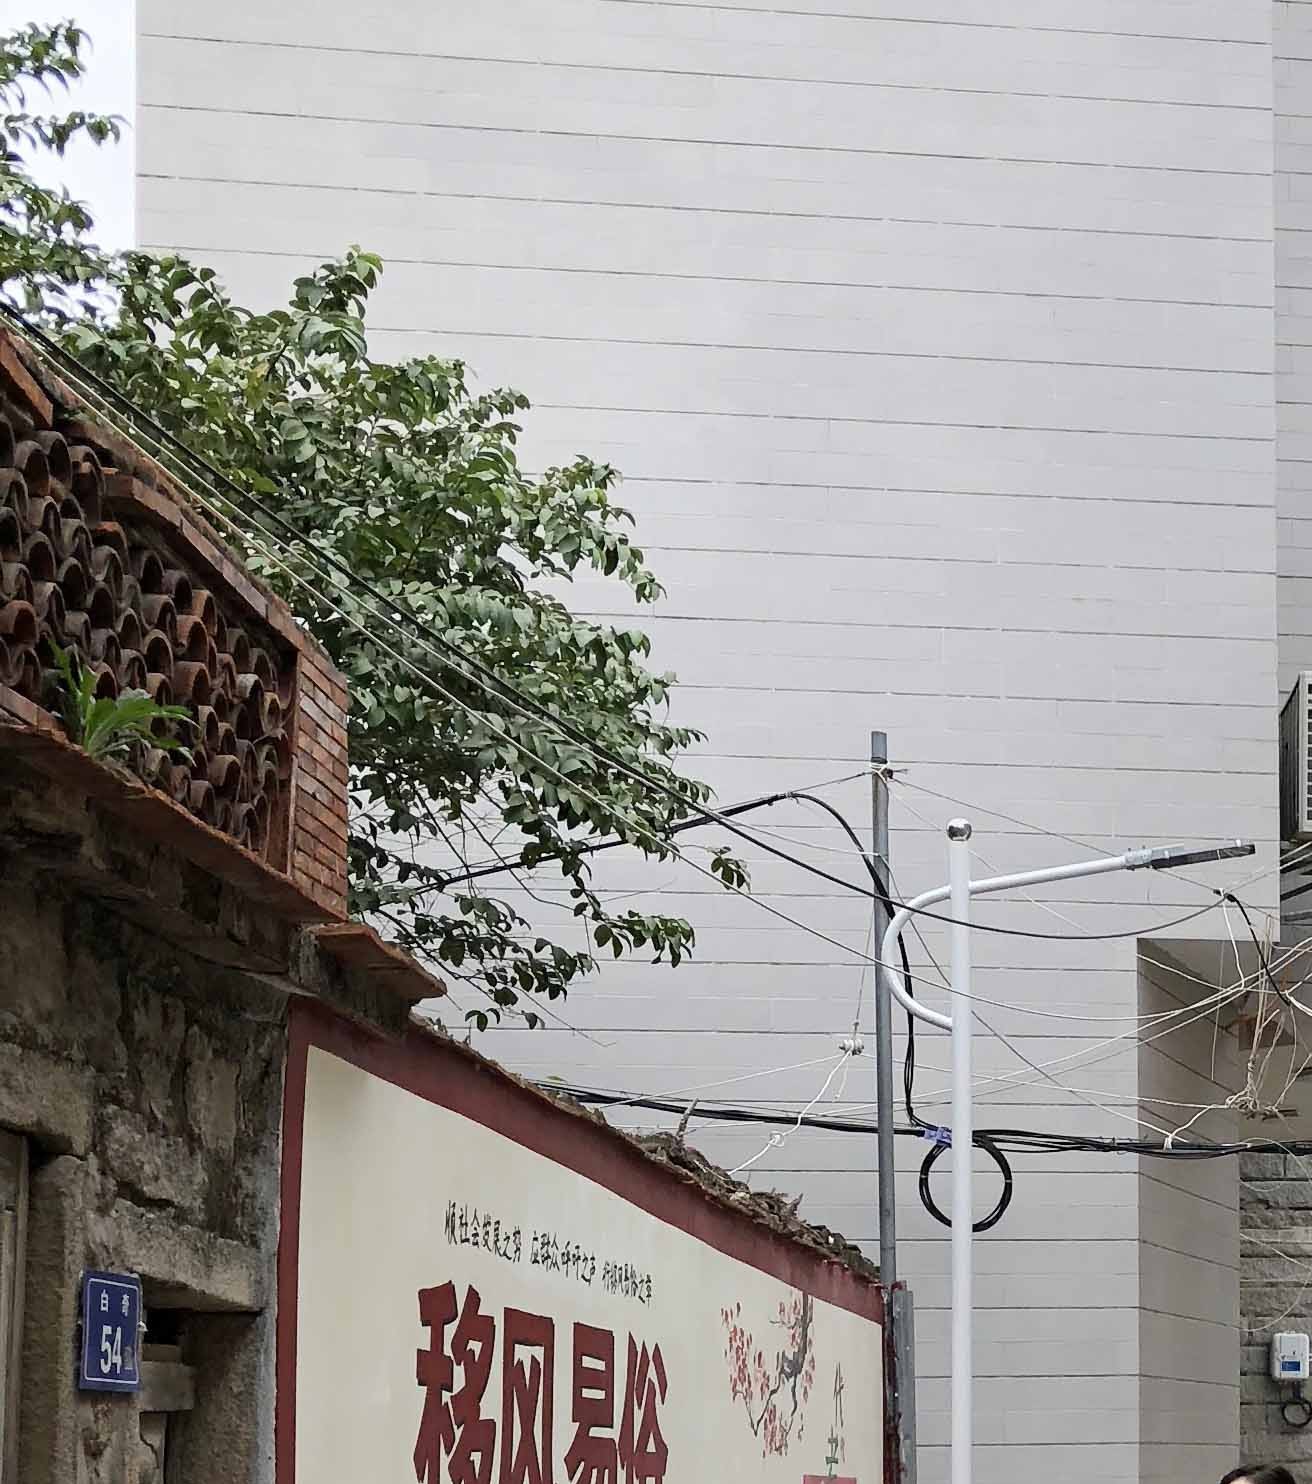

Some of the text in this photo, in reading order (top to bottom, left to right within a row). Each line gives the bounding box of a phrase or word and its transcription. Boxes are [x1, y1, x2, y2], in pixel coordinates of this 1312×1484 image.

[444, 1199, 522, 1264] 顺社会发展之势
